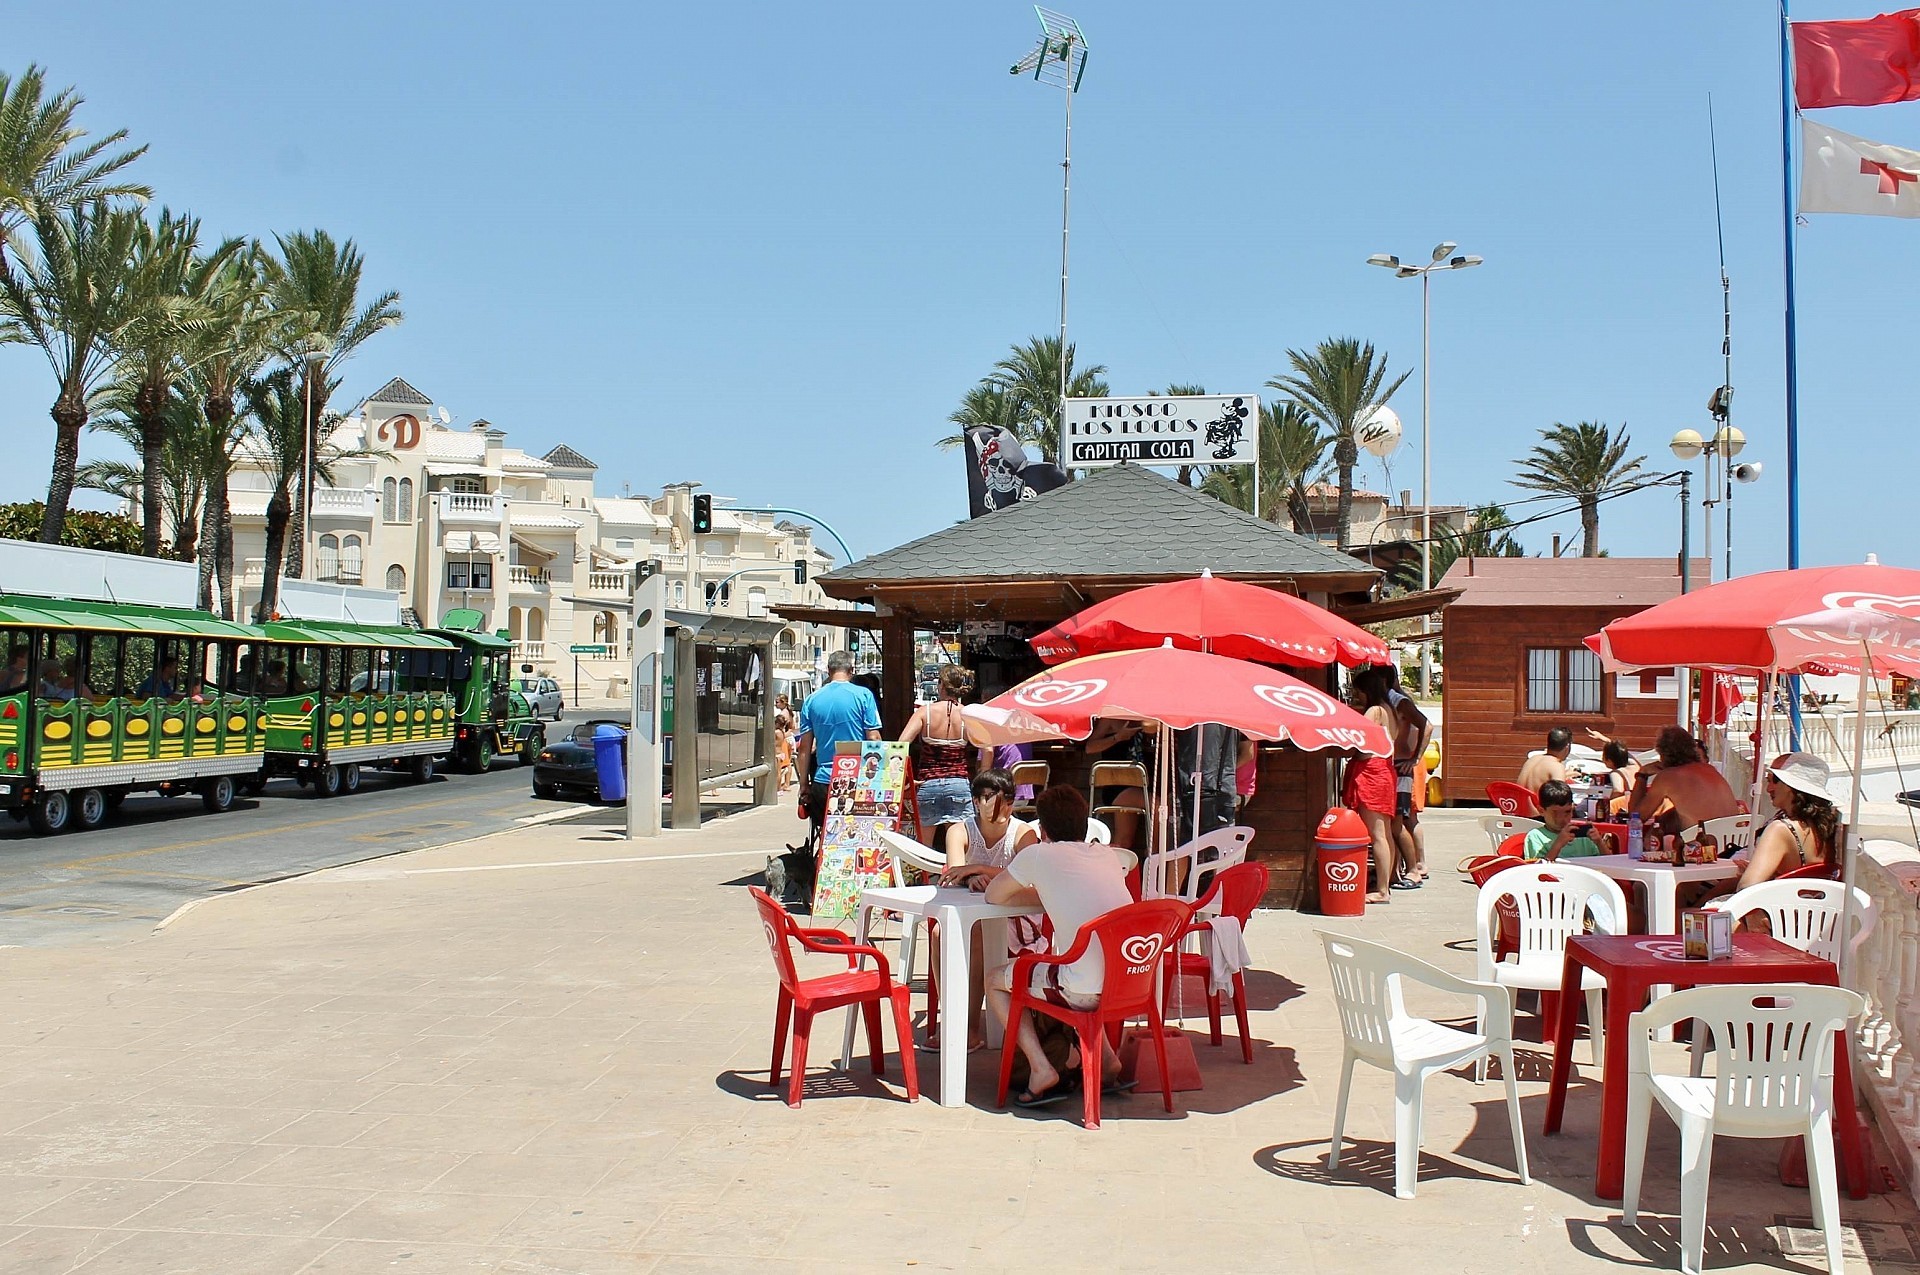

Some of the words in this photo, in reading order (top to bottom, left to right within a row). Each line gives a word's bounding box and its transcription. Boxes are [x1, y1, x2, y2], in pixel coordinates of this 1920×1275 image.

[1090, 402, 1178, 418] KIOSCO
[378, 413, 421, 451] D
[1070, 420, 1113, 436] LOS
[1121, 418, 1198, 435] LOCOS
[1150, 441, 1191, 458] COLA
[1327, 883, 1357, 893] FRIGO
[1126, 964, 1151, 975] FRIGO
